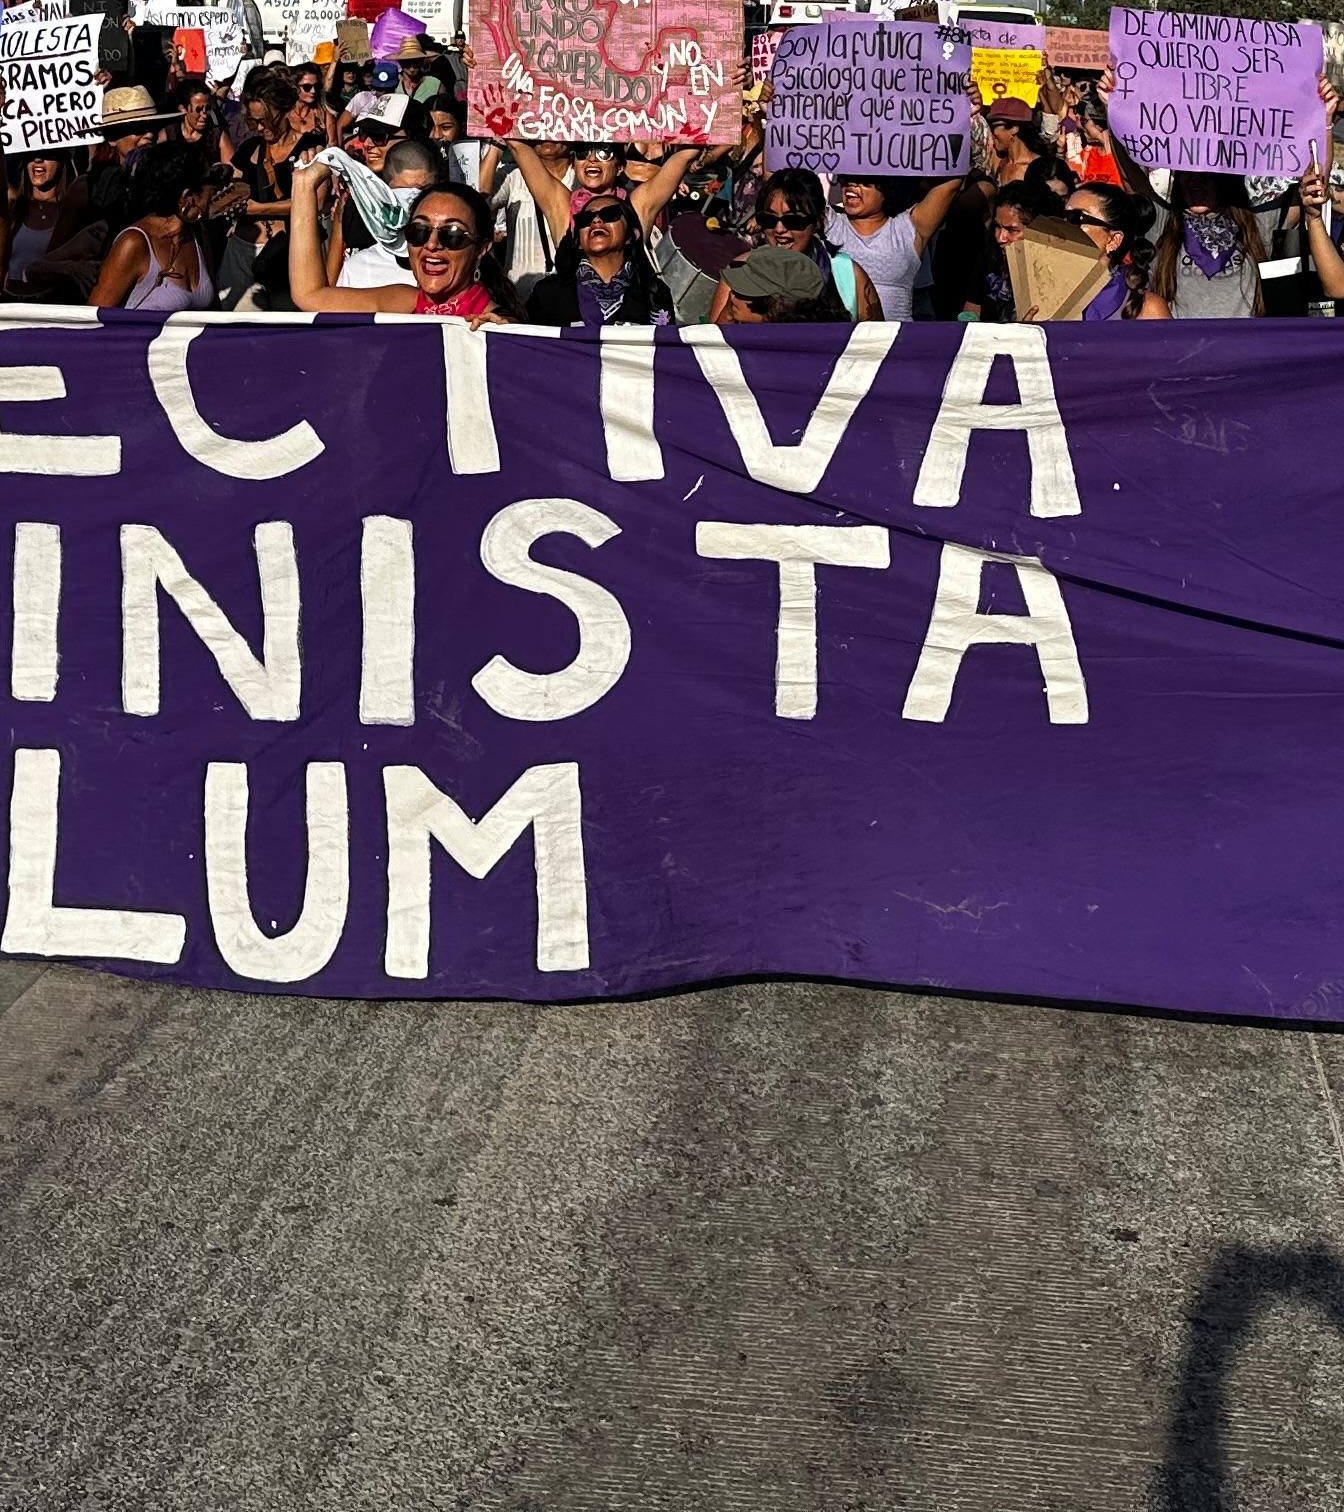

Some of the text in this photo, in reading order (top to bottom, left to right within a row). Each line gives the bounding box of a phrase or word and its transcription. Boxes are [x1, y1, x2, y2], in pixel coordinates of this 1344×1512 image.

[198, 10, 230, 30] espero
[304, 9, 341, 23] 20,000
[513, 12, 605, 44] LINDO
[1123, 8, 1155, 37] DE
[1157, 13, 1232, 43] CAMINO
[1233, 17, 1248, 44] A
[1249, 19, 1303, 48] CASA
[777, 22, 923, 67] Soy la futura
[933, 24, 973, 46] #8M
[998, 29, 1018, 46] de
[520, 39, 536, 67] Y
[668, 39, 703, 68] NO
[1137, 39, 1285, 74] QUIERO SER
[690, 60, 724, 96] EN
[770, 58, 866, 97] Psicóloga
[870, 65, 907, 98] que
[910, 63, 933, 94] te
[1181, 71, 1250, 103] LIBRE
[42, 90, 96, 115] PERO
[538, 85, 597, 125] FOSA
[699, 100, 719, 132] Y
[770, 89, 955, 129] entender qué NO ES
[1139, 101, 1296, 140] NO VALIENTE
[769, 124, 791, 149] NI
[795, 121, 846, 151] SERÁ
[850, 129, 883, 171] TÚ
[1122, 133, 1302, 173] #8M NI UNA MÁS
